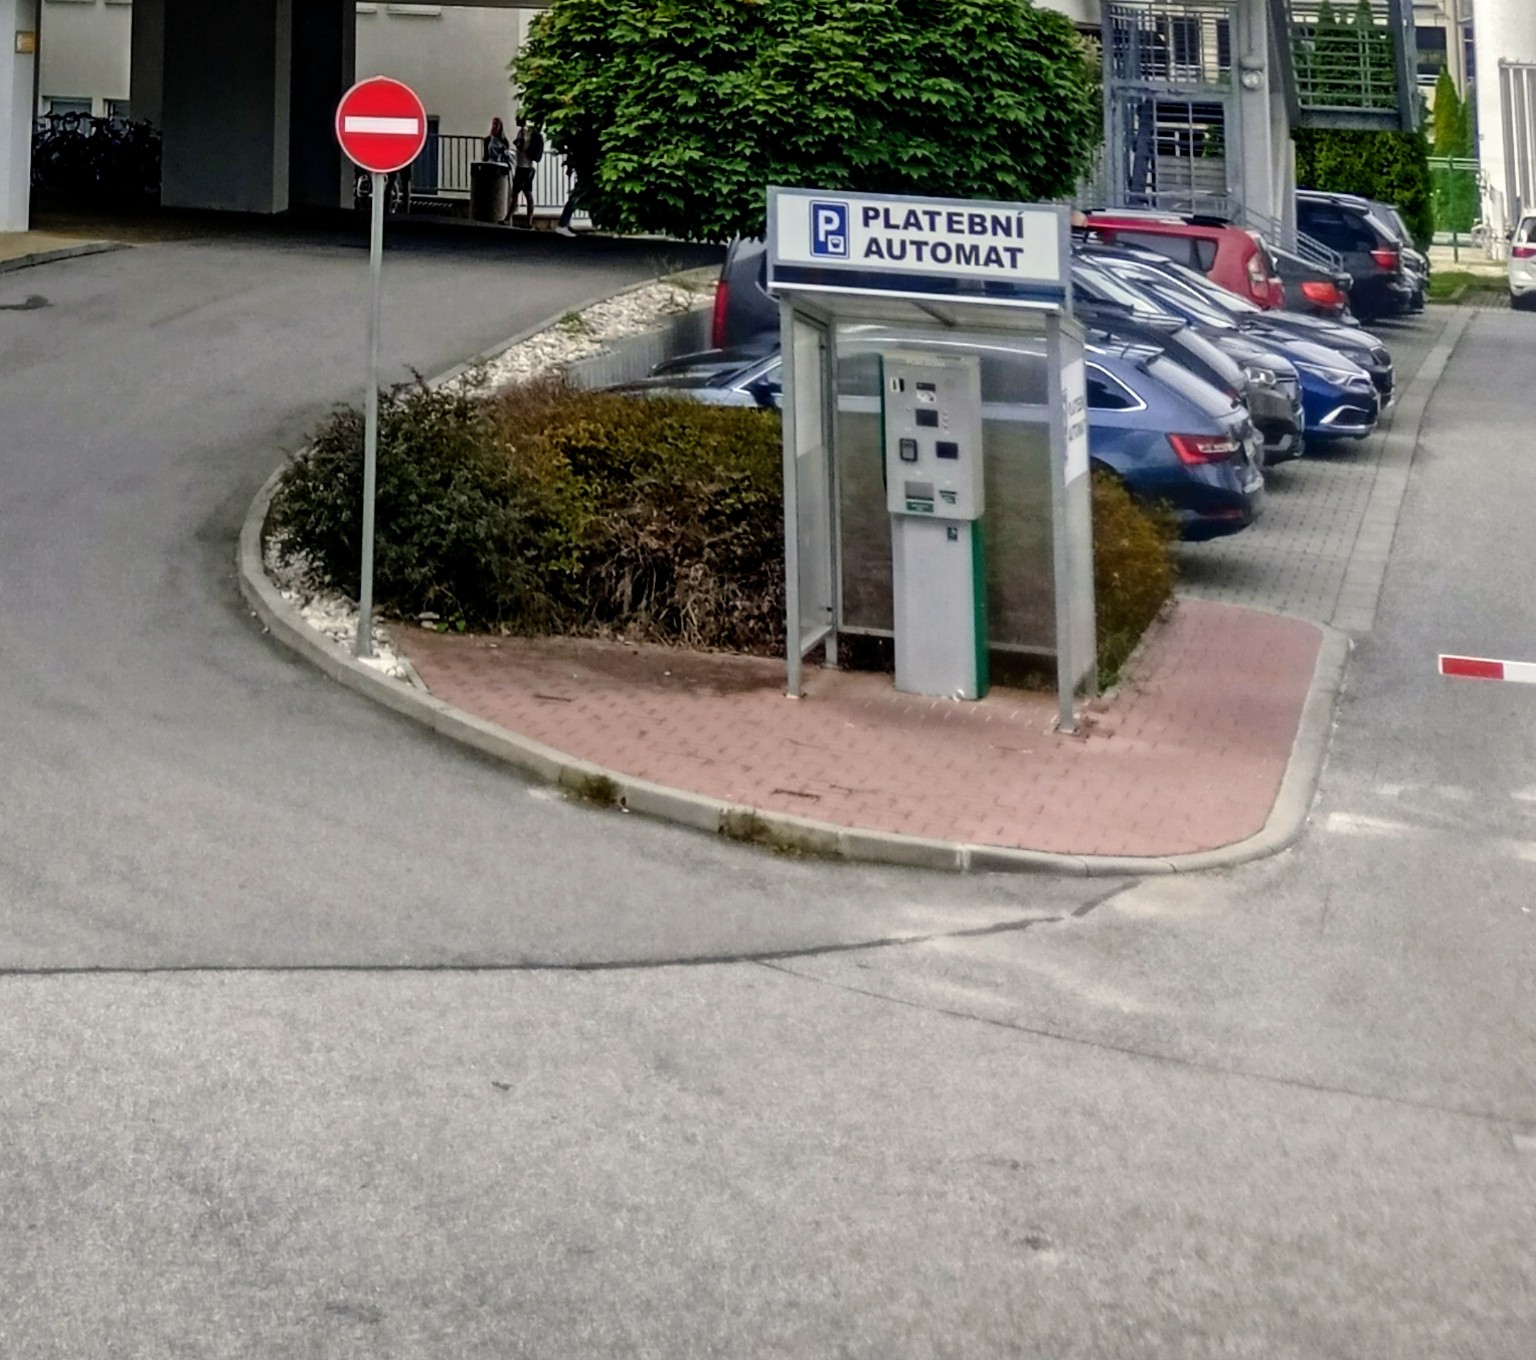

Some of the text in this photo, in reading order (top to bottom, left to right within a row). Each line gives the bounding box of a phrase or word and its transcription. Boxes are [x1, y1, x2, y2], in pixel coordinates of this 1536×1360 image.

[818, 209, 841, 243] P
[861, 206, 1025, 240] PLATEBNÍ
[862, 236, 1025, 270] AUTOMAT
